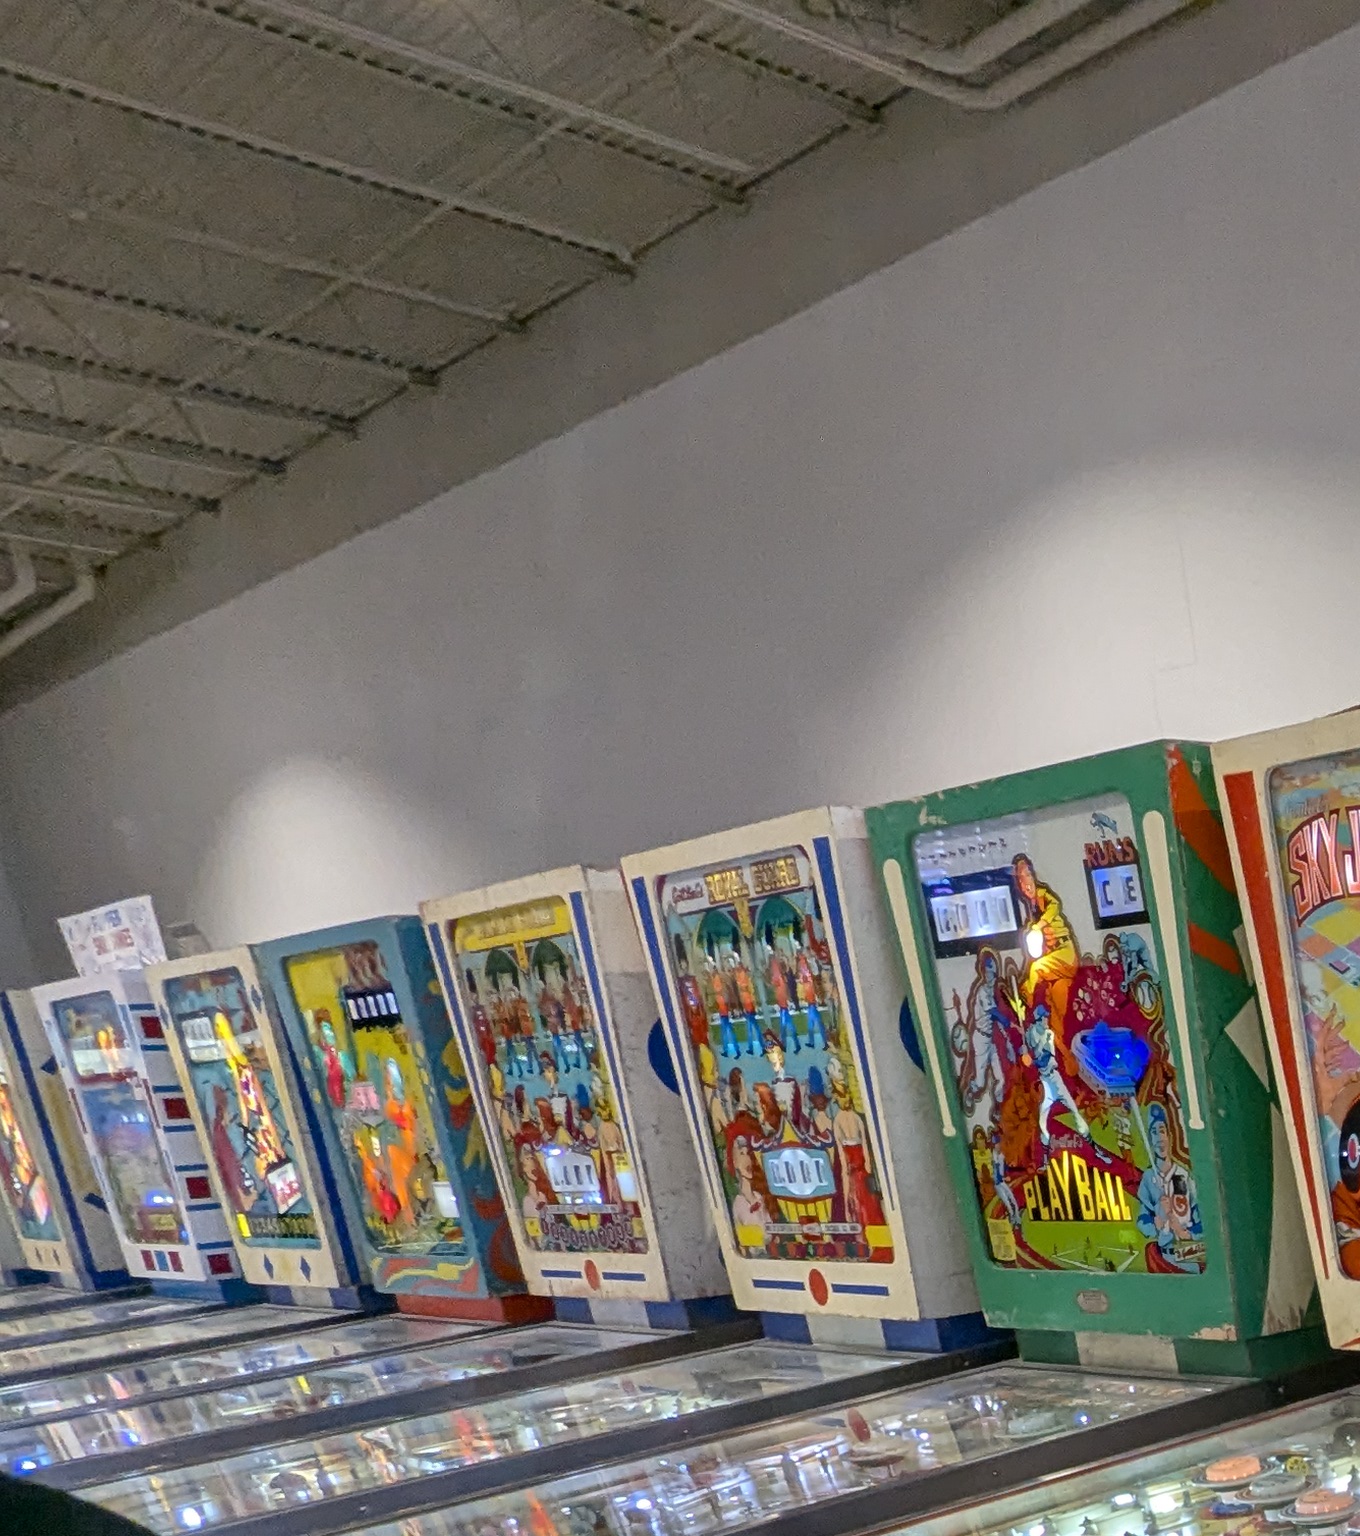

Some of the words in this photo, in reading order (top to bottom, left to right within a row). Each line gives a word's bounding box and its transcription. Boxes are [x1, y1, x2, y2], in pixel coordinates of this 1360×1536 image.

[1083, 837, 1136, 868] RUNS
[1289, 813, 1344, 918] SKY
[1023, 1150, 1073, 1221] PLAY
[1071, 1154, 1133, 1221] BALL
